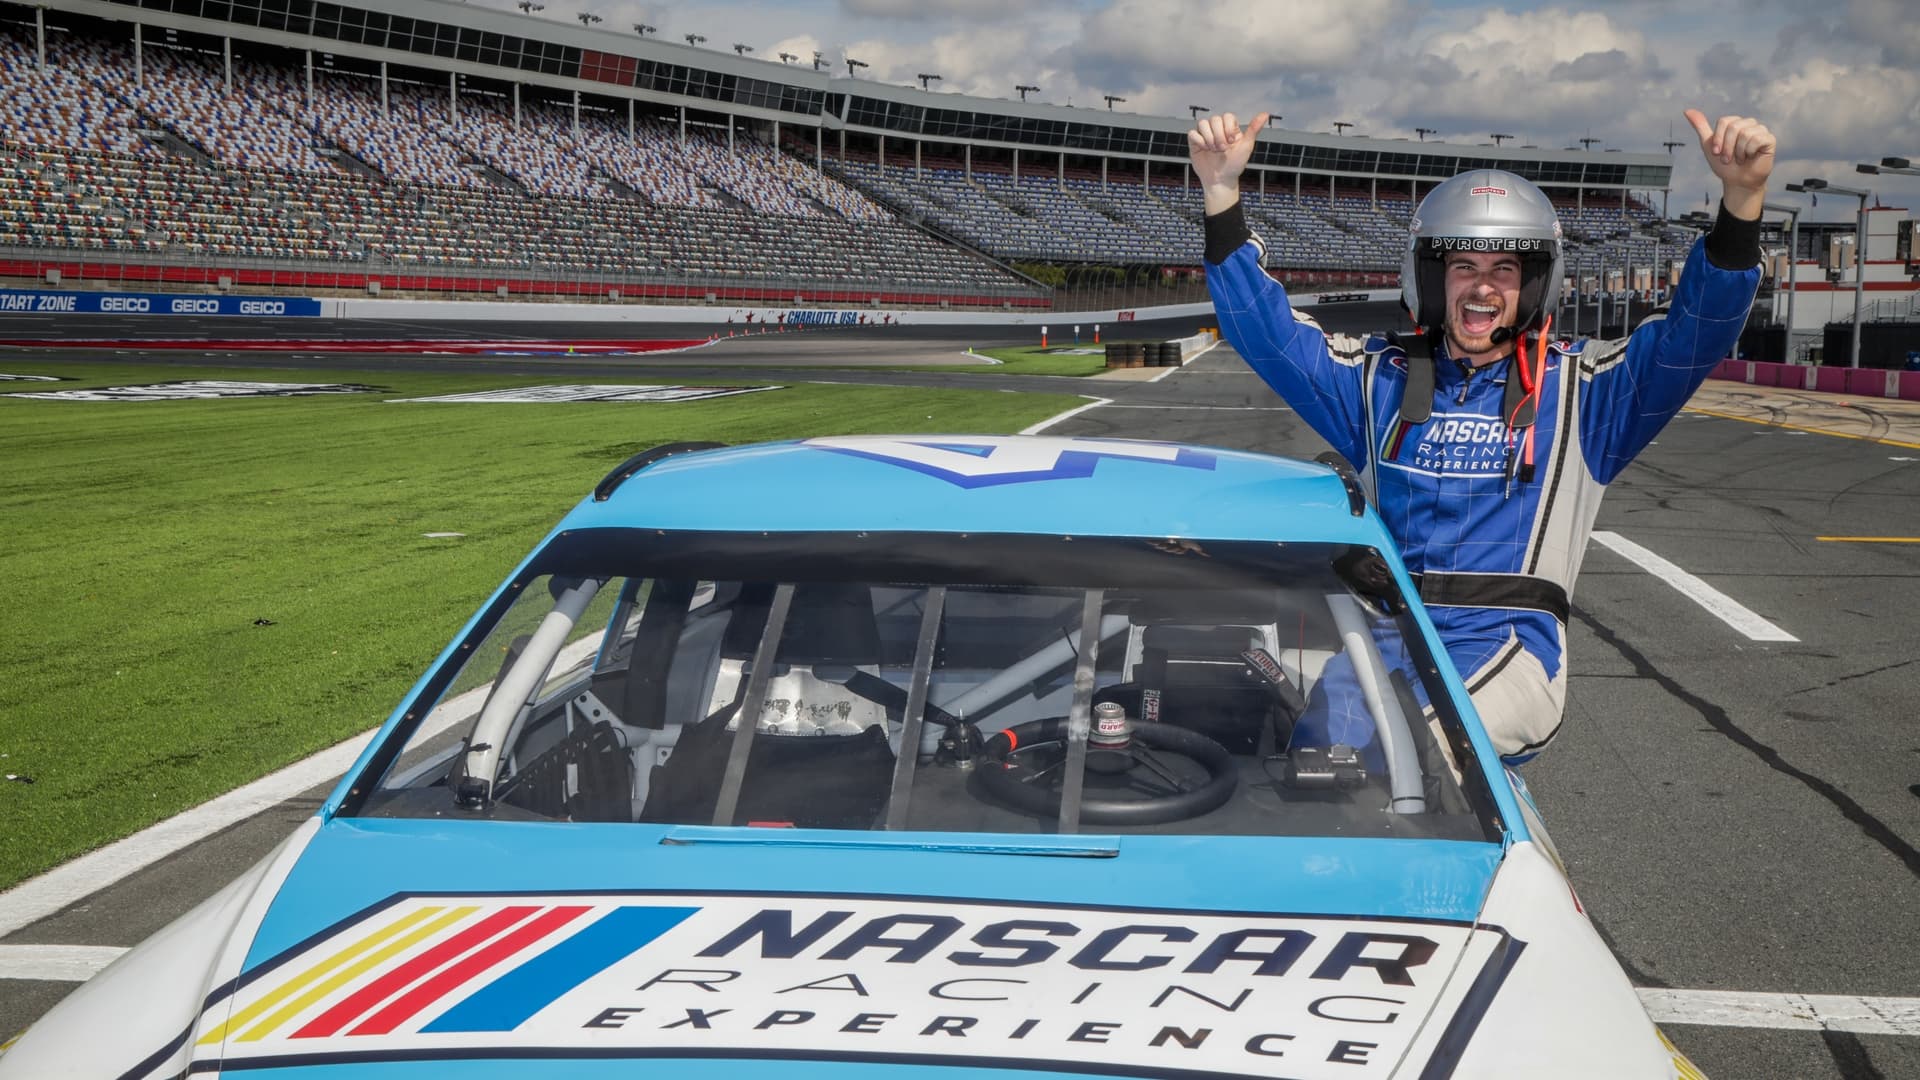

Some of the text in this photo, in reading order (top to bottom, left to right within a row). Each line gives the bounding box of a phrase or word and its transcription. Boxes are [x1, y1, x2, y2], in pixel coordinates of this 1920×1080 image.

[1431, 237, 1541, 251] PYROTECT
[37, 295, 77, 311] ZONE
[100, 297, 150, 312] GEICO
[171, 299, 219, 314] GEICO
[239, 301, 285, 315] GEICO
[787, 310, 858, 325] CHARLOTTE USA
[694, 910, 1440, 986] NASCAR
[635, 969, 1406, 1024] RACING
[582, 1007, 1378, 1066] EXPERIENCE
